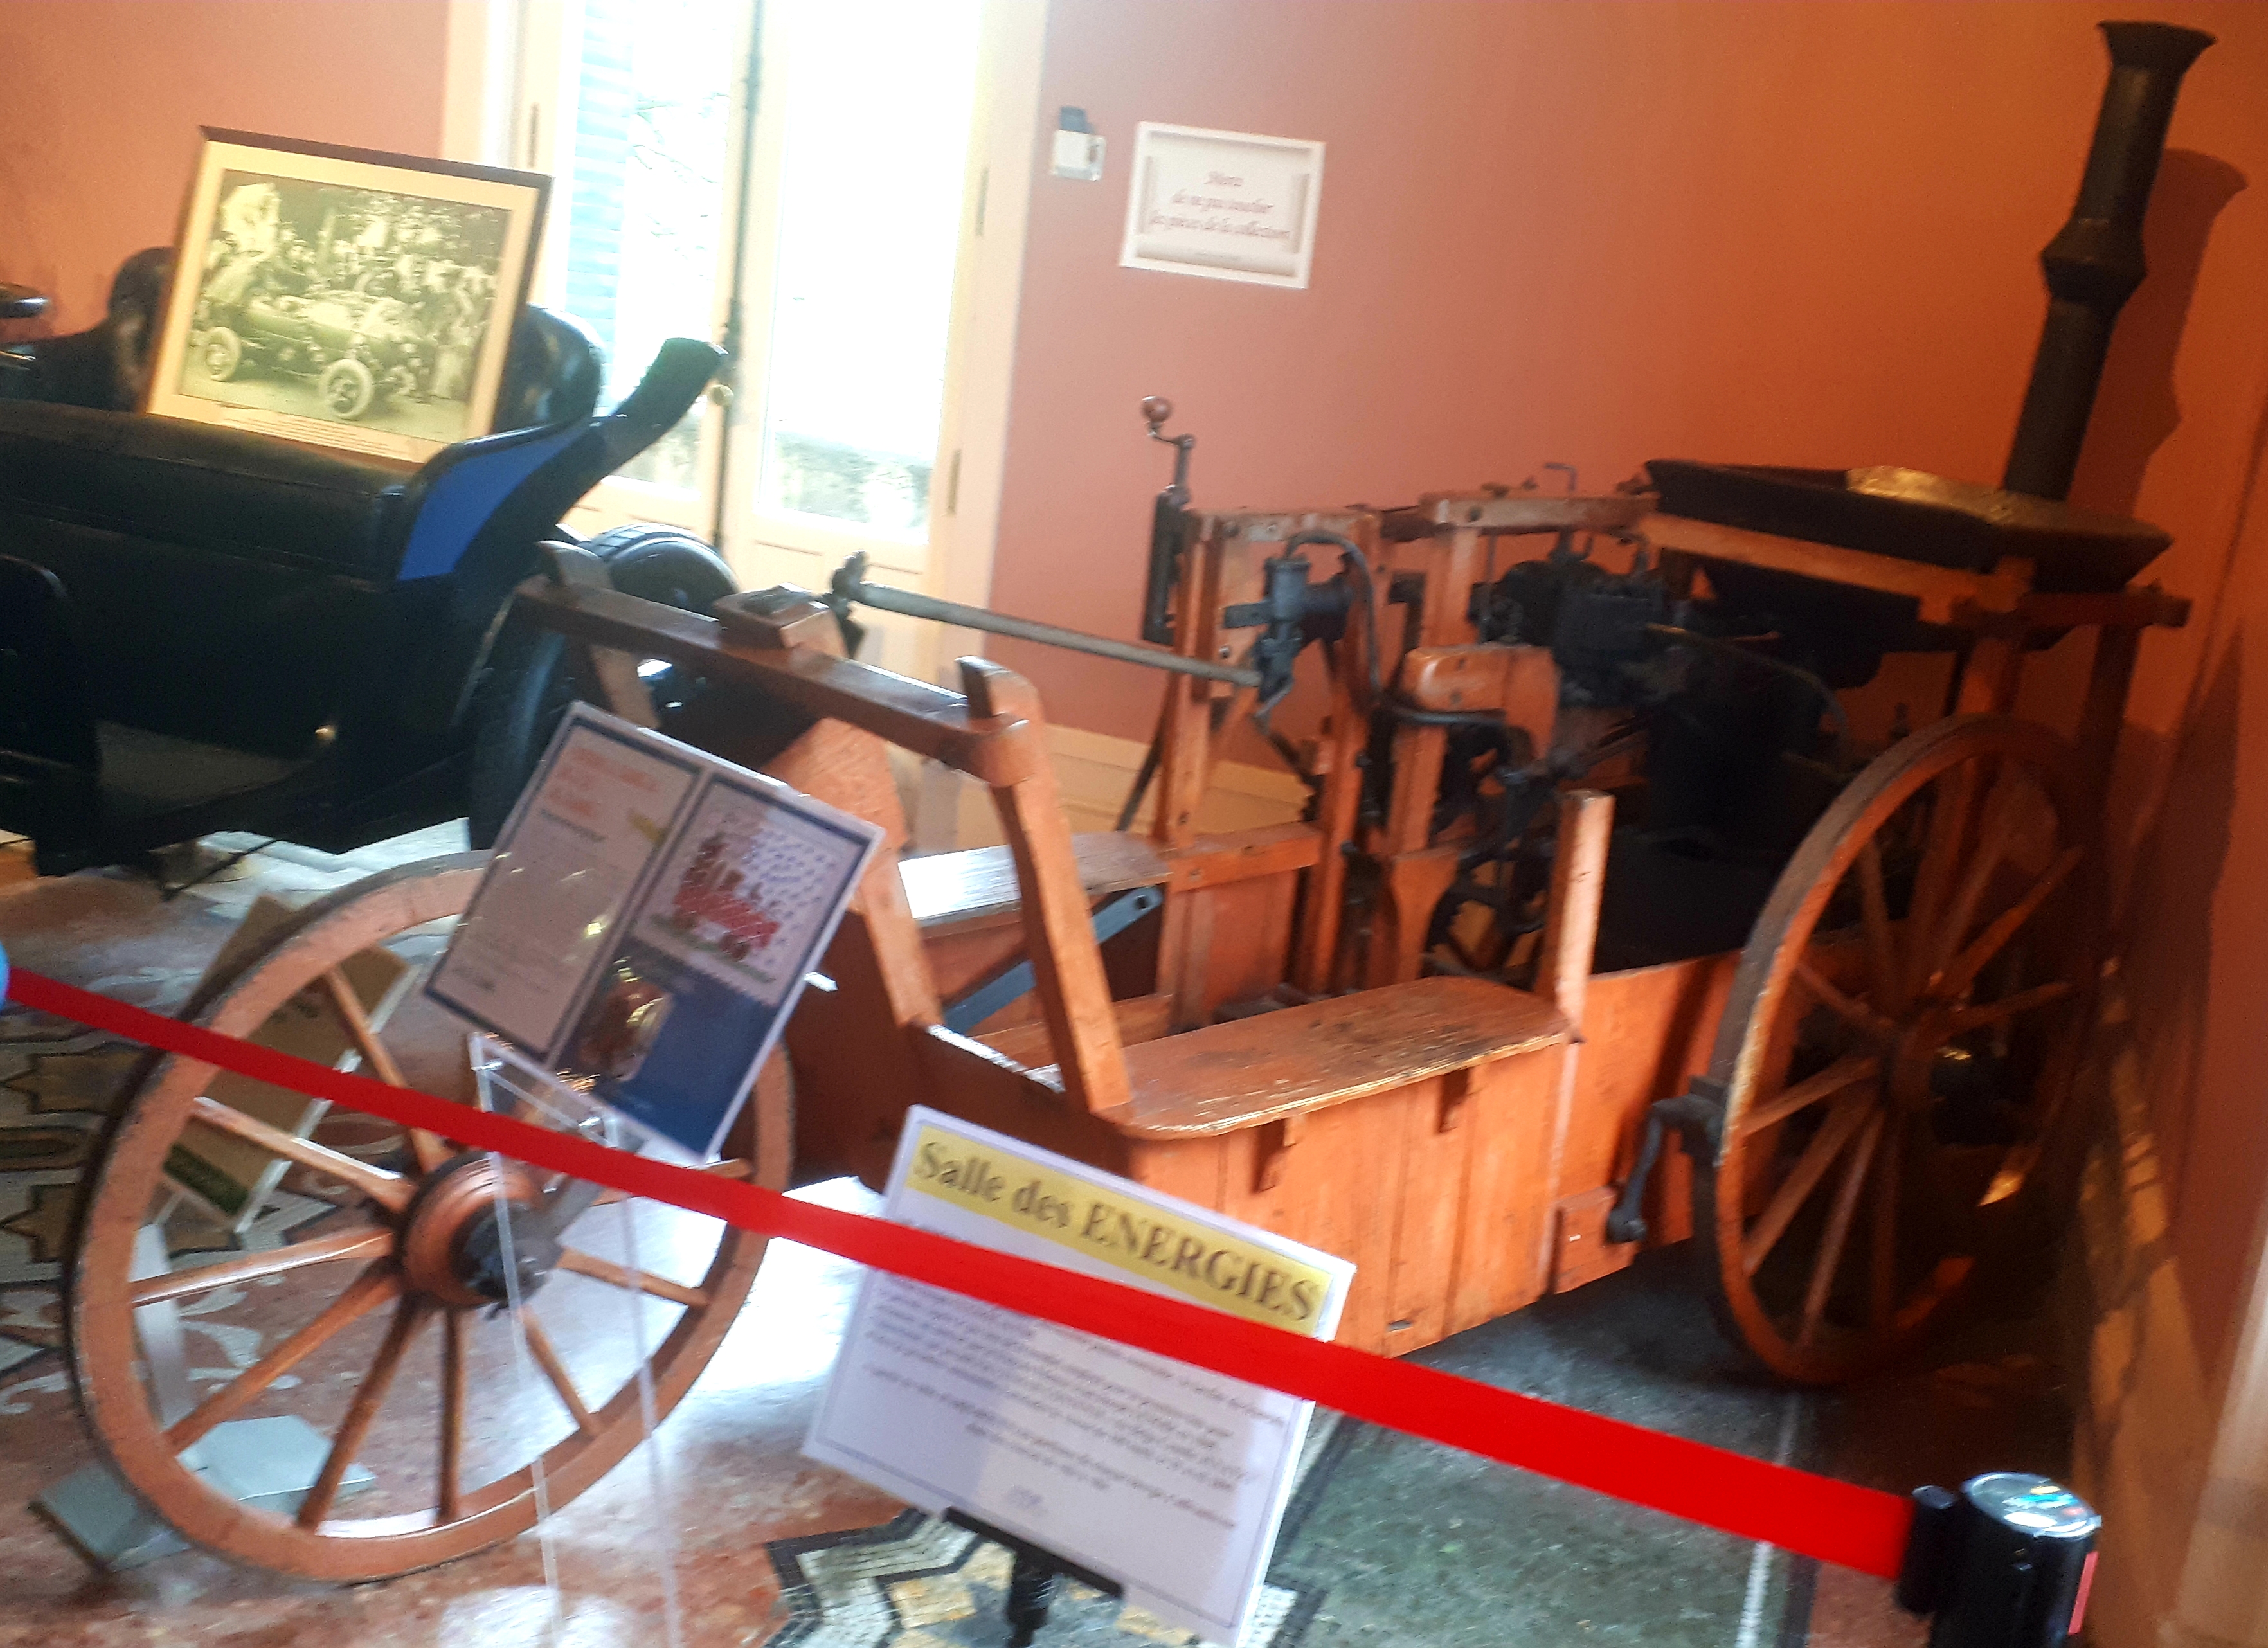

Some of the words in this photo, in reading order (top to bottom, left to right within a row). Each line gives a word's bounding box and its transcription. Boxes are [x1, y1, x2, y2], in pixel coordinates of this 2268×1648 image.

[912, 1142, 1007, 1203] Salle
[1011, 1180, 1071, 1230] des
[1080, 1202, 1318, 1321] ENERGIES
